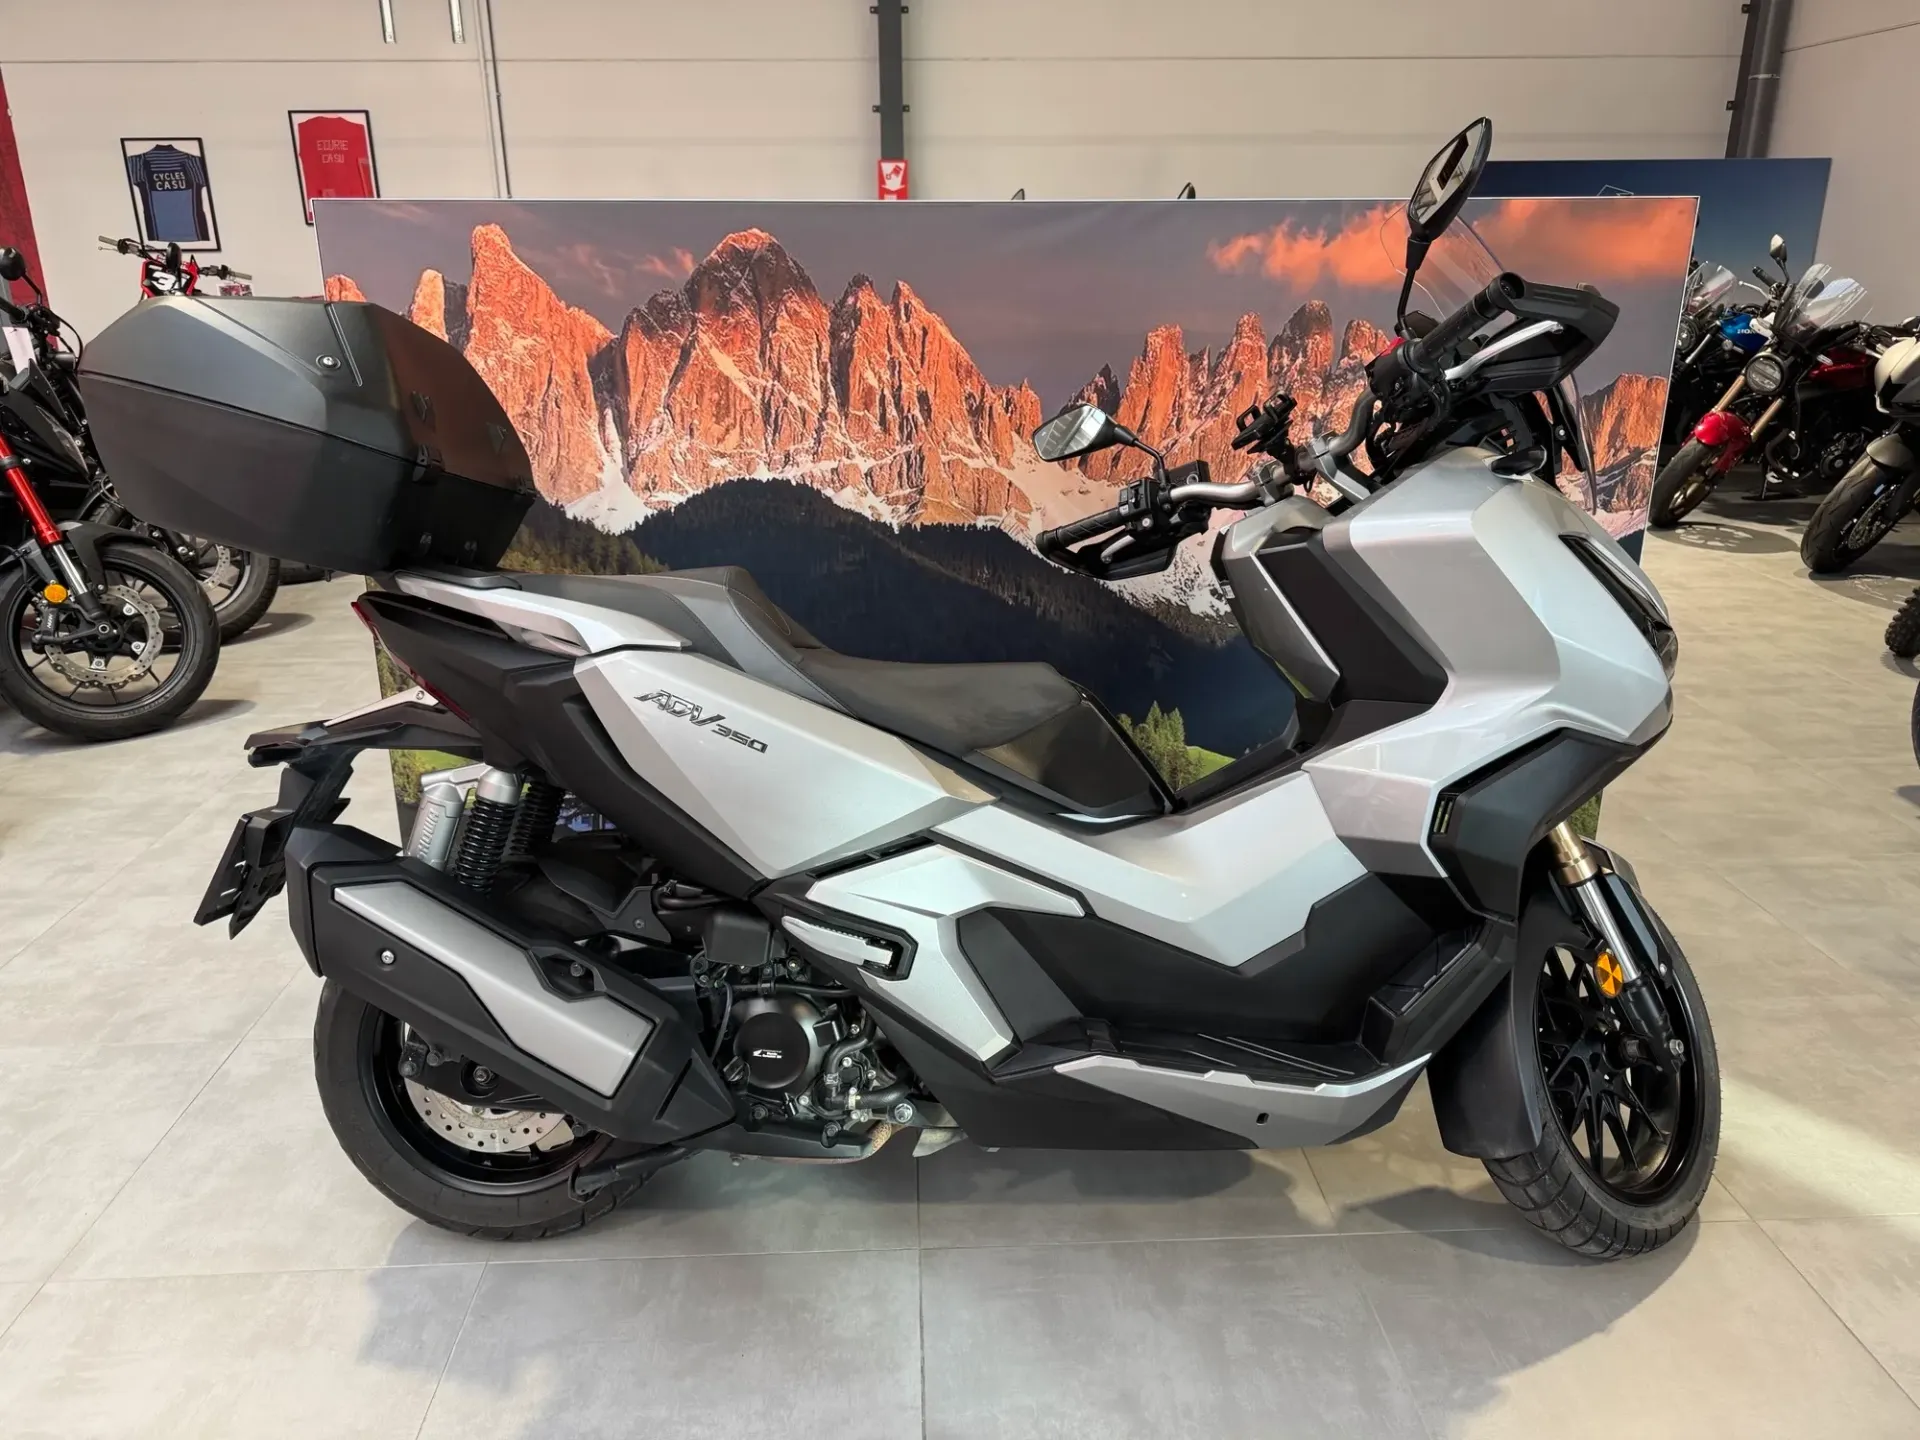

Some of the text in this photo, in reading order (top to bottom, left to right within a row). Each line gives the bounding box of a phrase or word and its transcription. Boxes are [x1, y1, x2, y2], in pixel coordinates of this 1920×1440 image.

[322, 153, 345, 163] CASU
[153, 171, 186, 181] CYCLES
[156, 180, 186, 190] CASU
